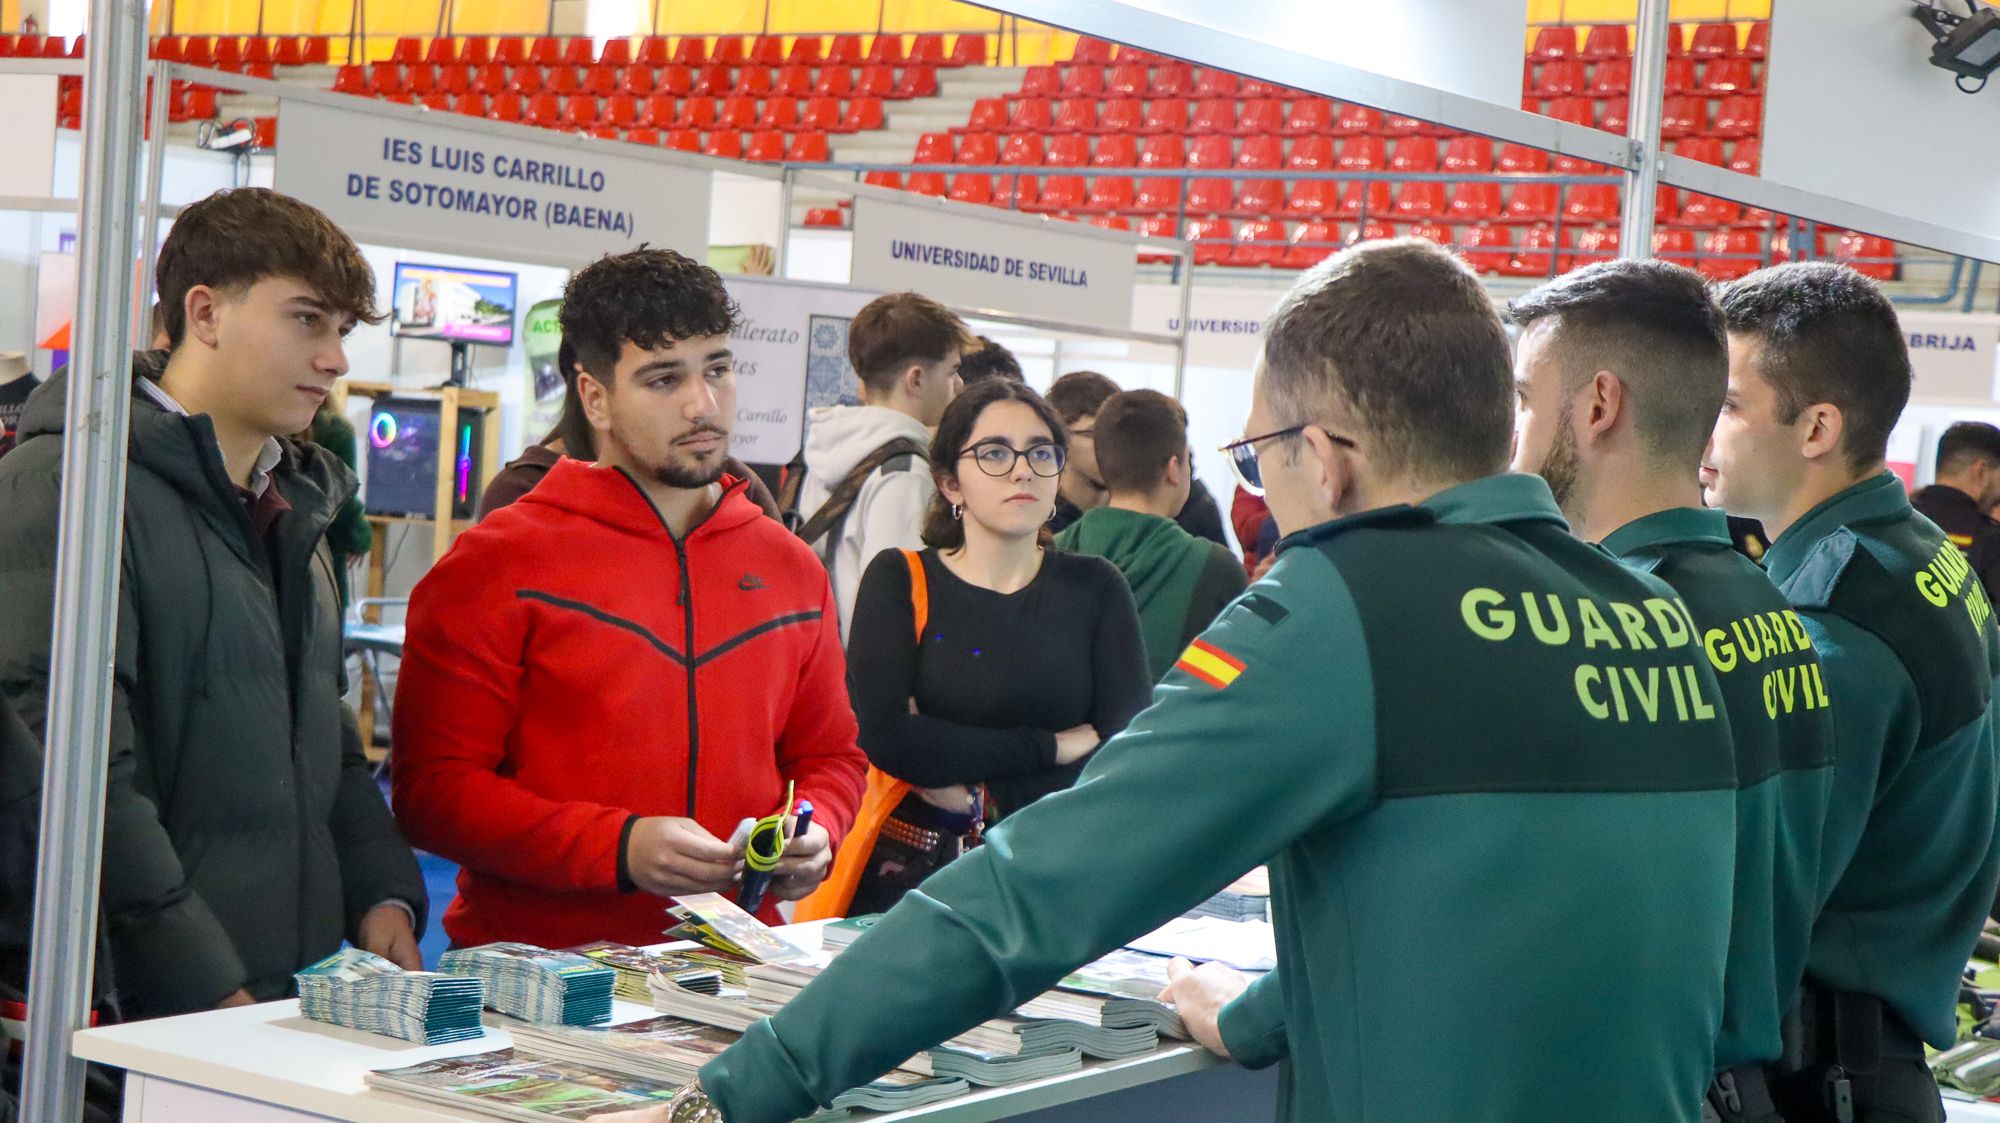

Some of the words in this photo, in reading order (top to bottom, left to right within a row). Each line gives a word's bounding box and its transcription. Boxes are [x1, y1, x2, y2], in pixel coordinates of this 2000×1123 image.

[384, 138, 422, 164] IES
[432, 146, 485, 174] LUIS
[493, 156, 605, 192] CARRILLO
[347, 173, 380, 199] DE
[389, 180, 537, 221] SOTOMAYOR
[545, 202, 634, 238] (BAENA)
[892, 240, 999, 273] UNIVERSIDAD
[1005, 258, 1024, 277] DE
[1029, 262, 1088, 288] SEVILLA
[737, 408, 788, 424] Carrillo
[1574, 664, 1716, 722] CIVIL
